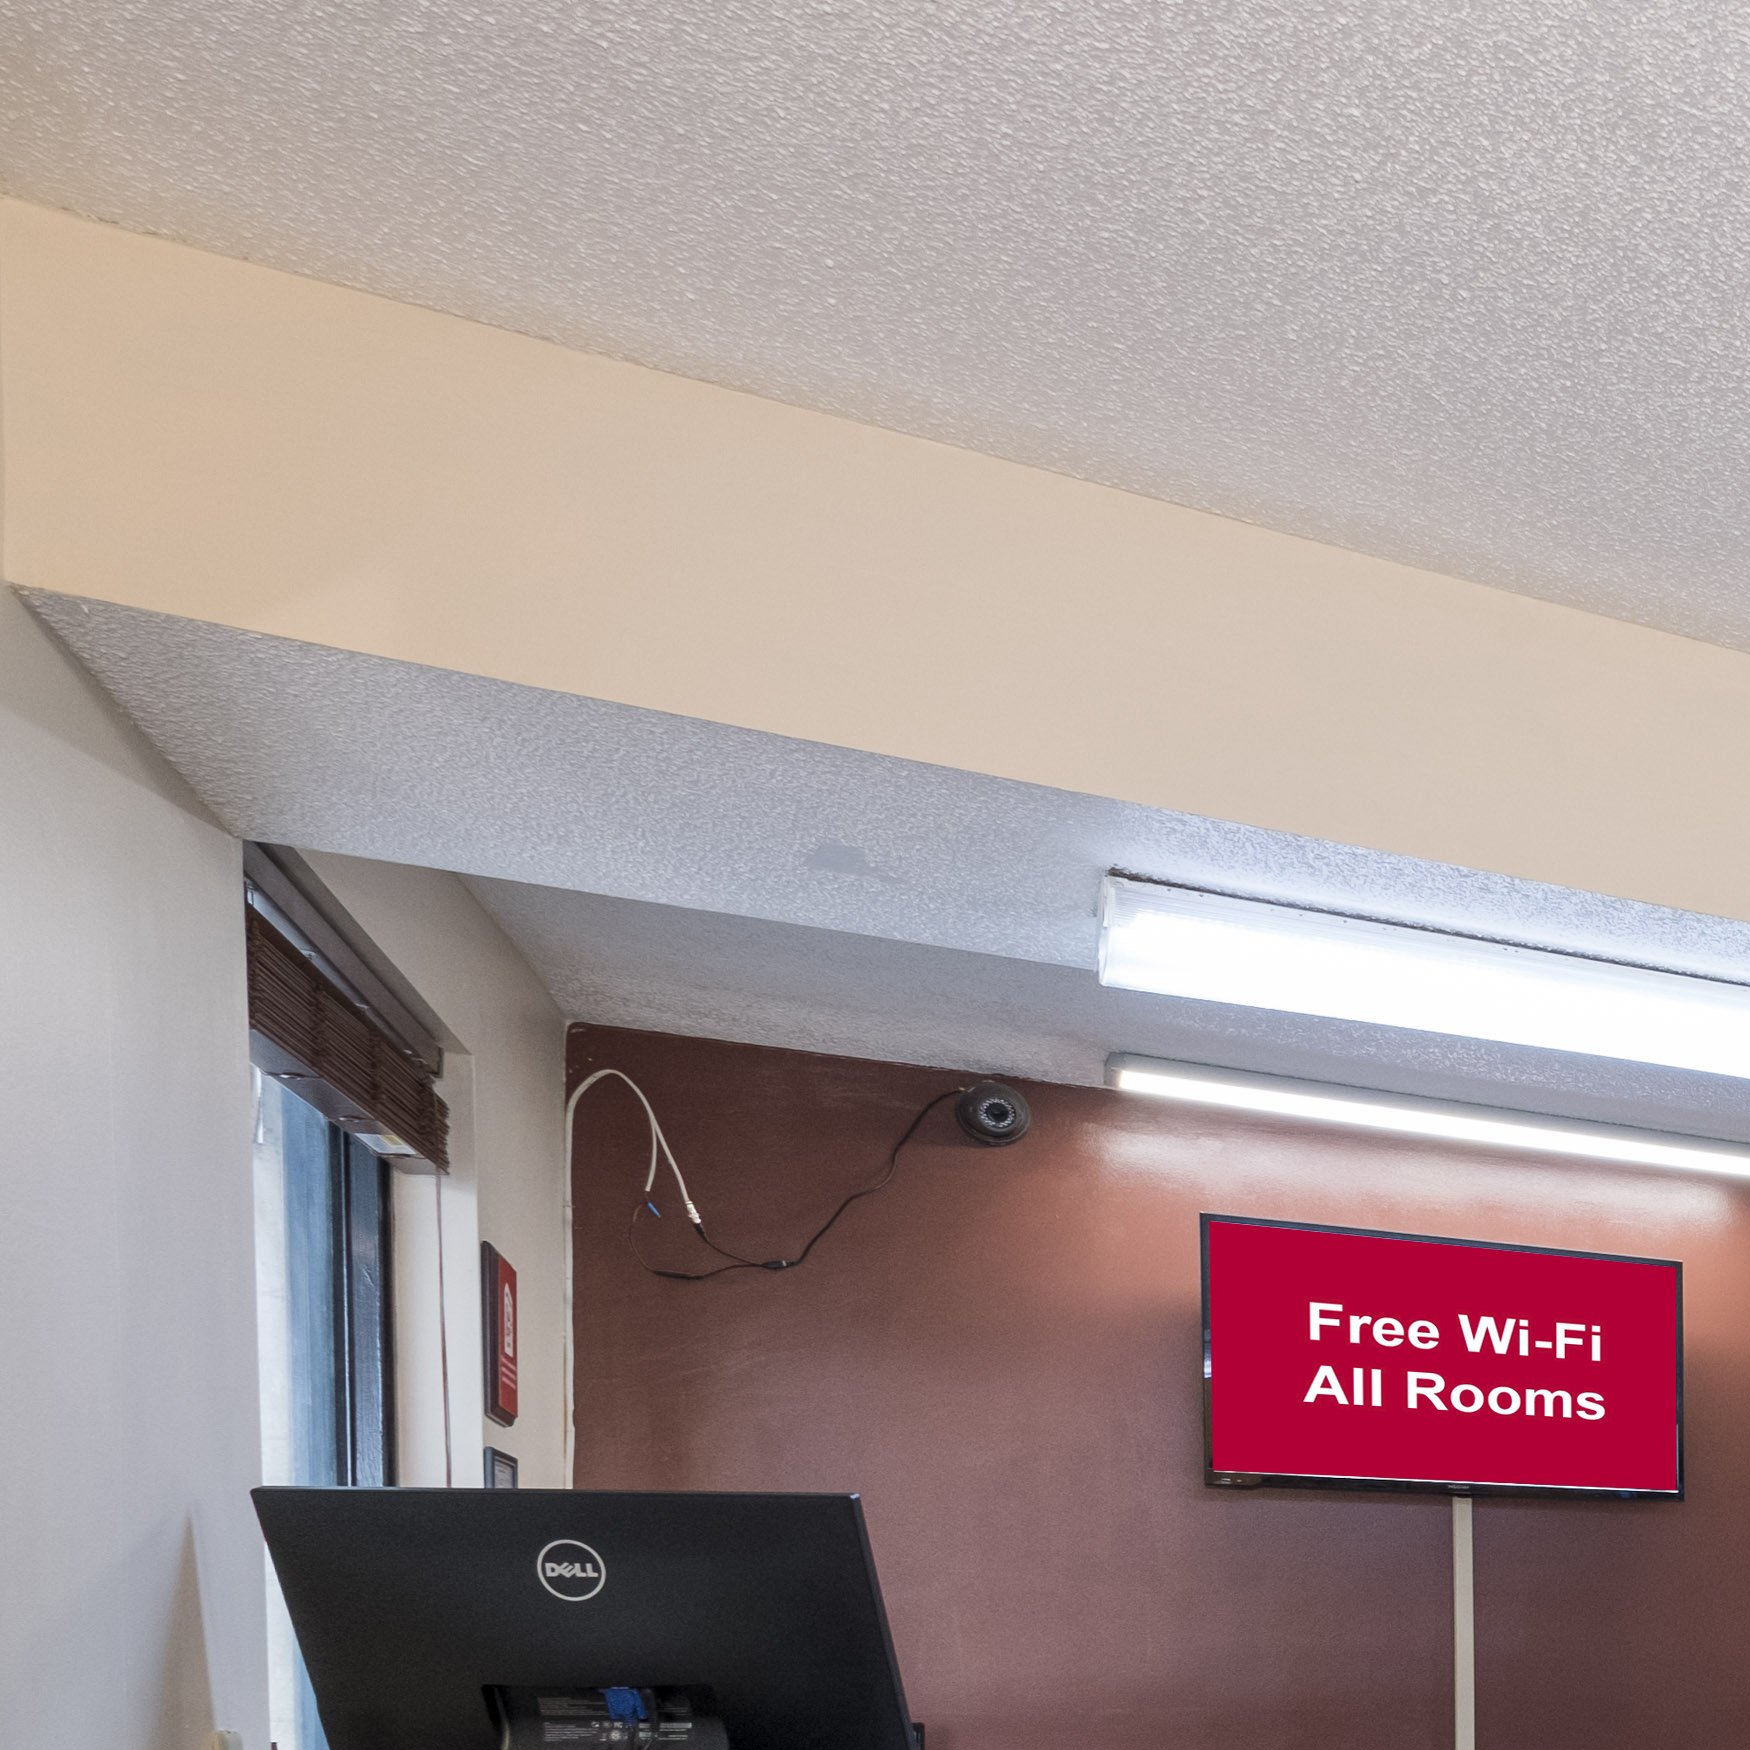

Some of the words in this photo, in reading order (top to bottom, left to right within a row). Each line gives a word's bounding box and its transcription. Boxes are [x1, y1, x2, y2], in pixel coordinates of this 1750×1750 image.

[1309, 1301, 1440, 1350] Free
[1457, 1313, 1601, 1362] Wi-Fi
[1303, 1365, 1382, 1407] All
[1407, 1371, 1606, 1421] Rooms
[544, 1562, 600, 1578] DELL
